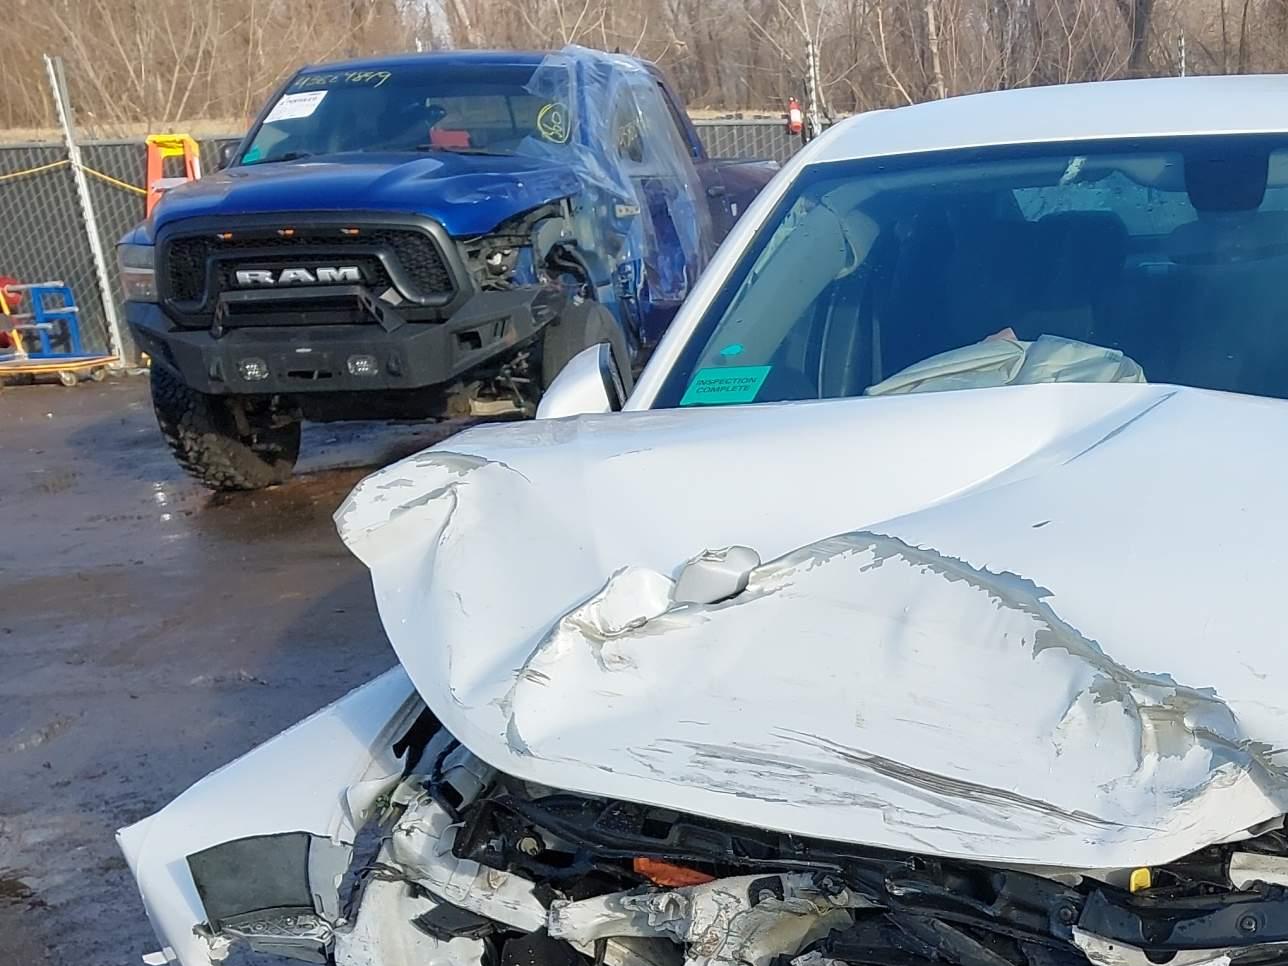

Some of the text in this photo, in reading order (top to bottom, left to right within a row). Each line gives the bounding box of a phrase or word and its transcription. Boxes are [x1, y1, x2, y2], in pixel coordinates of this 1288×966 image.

[236, 266, 361, 284] RAM
[696, 377, 757, 386] INSPECTION
[696, 385, 749, 393] COMPLETE
